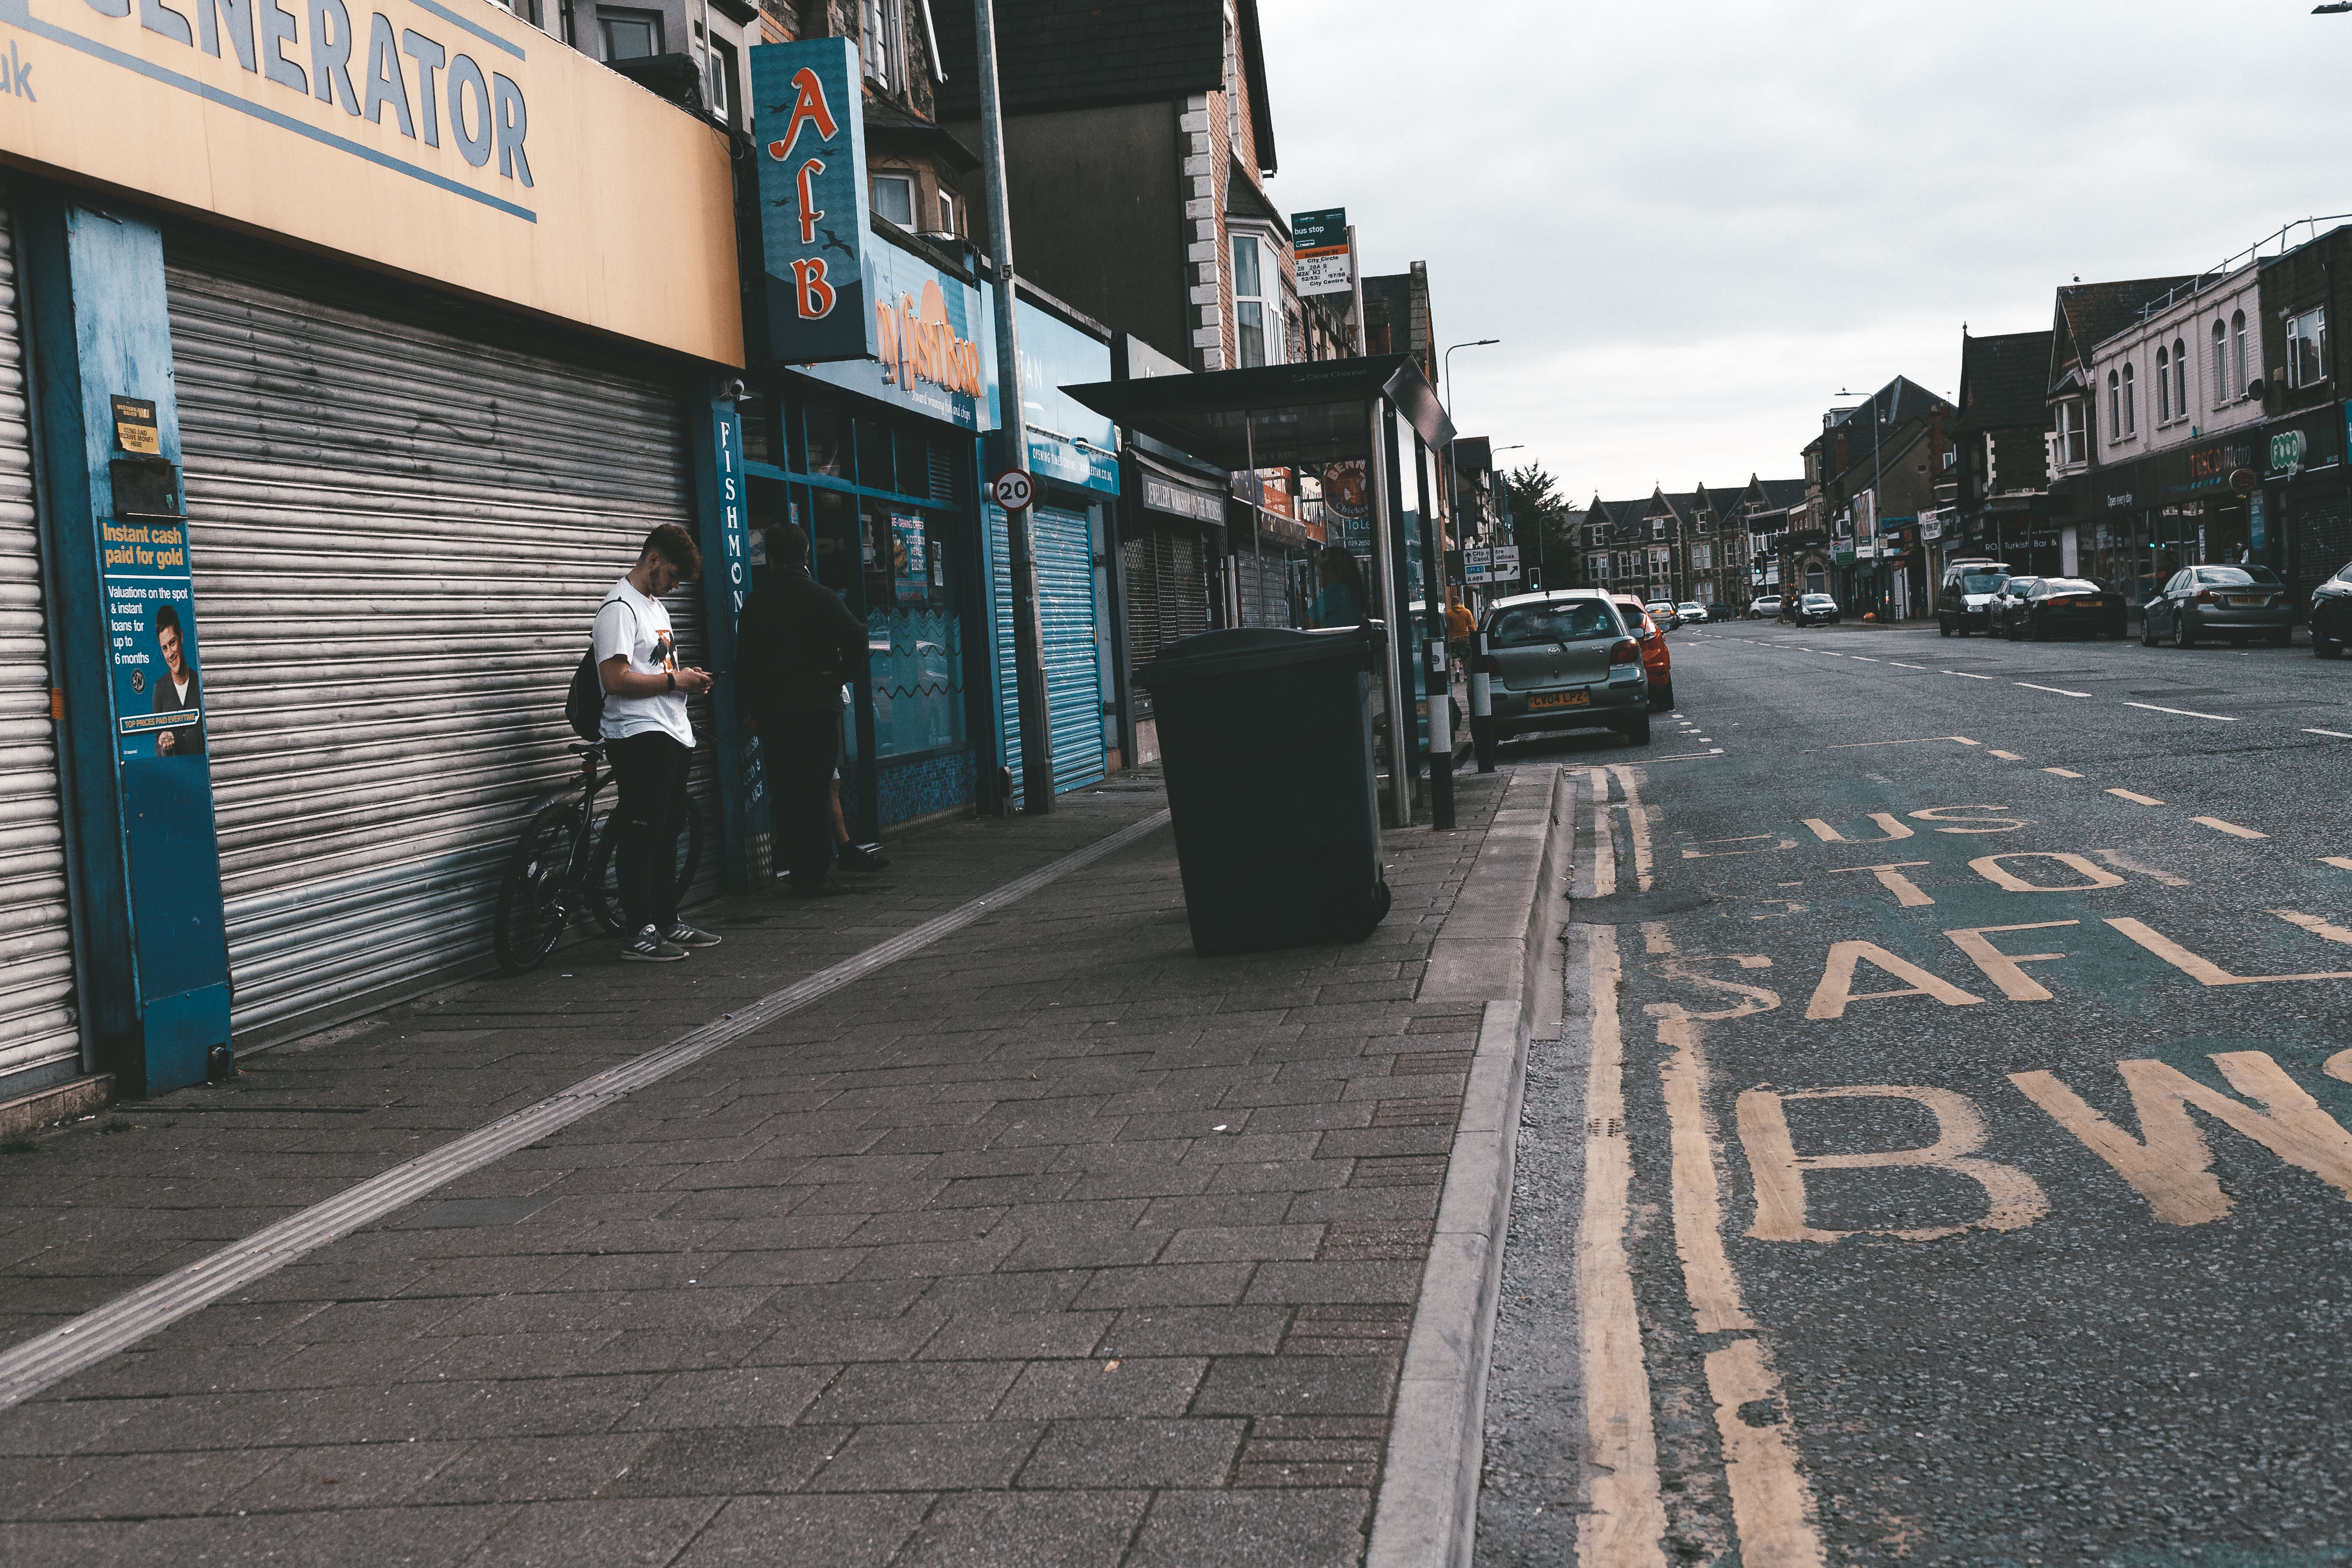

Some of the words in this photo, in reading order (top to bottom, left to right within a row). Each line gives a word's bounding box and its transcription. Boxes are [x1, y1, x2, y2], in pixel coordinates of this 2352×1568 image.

[82, 0, 534, 188] NERATOR
[1003, 265, 1011, 279] 5
[953, 404, 961, 417] and
[961, 405, 971, 423] chips
[1032, 447, 1051, 464] OPENING
[2189, 449, 2221, 477] TESCO
[999, 480, 1028, 500] 20
[720, 422, 743, 634] FISHMON
[1361, 520, 1370, 530] Le
[102, 523, 150, 543] Instant
[151, 527, 182, 544] cash
[906, 535, 909, 544] 2
[909, 535, 918, 545] COD
[2005, 541, 2029, 549] Turkish
[105, 545, 134, 568] paid
[136, 546, 153, 565] for
[157, 548, 184, 570] gold
[108, 586, 147, 599] Valuations
[148, 589, 158, 599] on
[159, 587, 171, 599] the
[172, 588, 188, 601] spot
[111, 603, 117, 614] &
[118, 602, 143, 614] instant
[111, 619, 132, 632] loans
[134, 619, 144, 632] for
[114, 637, 124, 649] up
[125, 635, 133, 647] to
[115, 653, 121, 664] 6
[122, 652, 150, 664] months
[1534, 693, 1560, 705] CV04
[1563, 692, 1583, 702] LPZ
[124, 720, 136, 729] TOP
[136, 718, 155, 727] PRICES
[167, 713, 196, 723] EVERYTIME
[1737, 1048, 2352, 1243] BW
